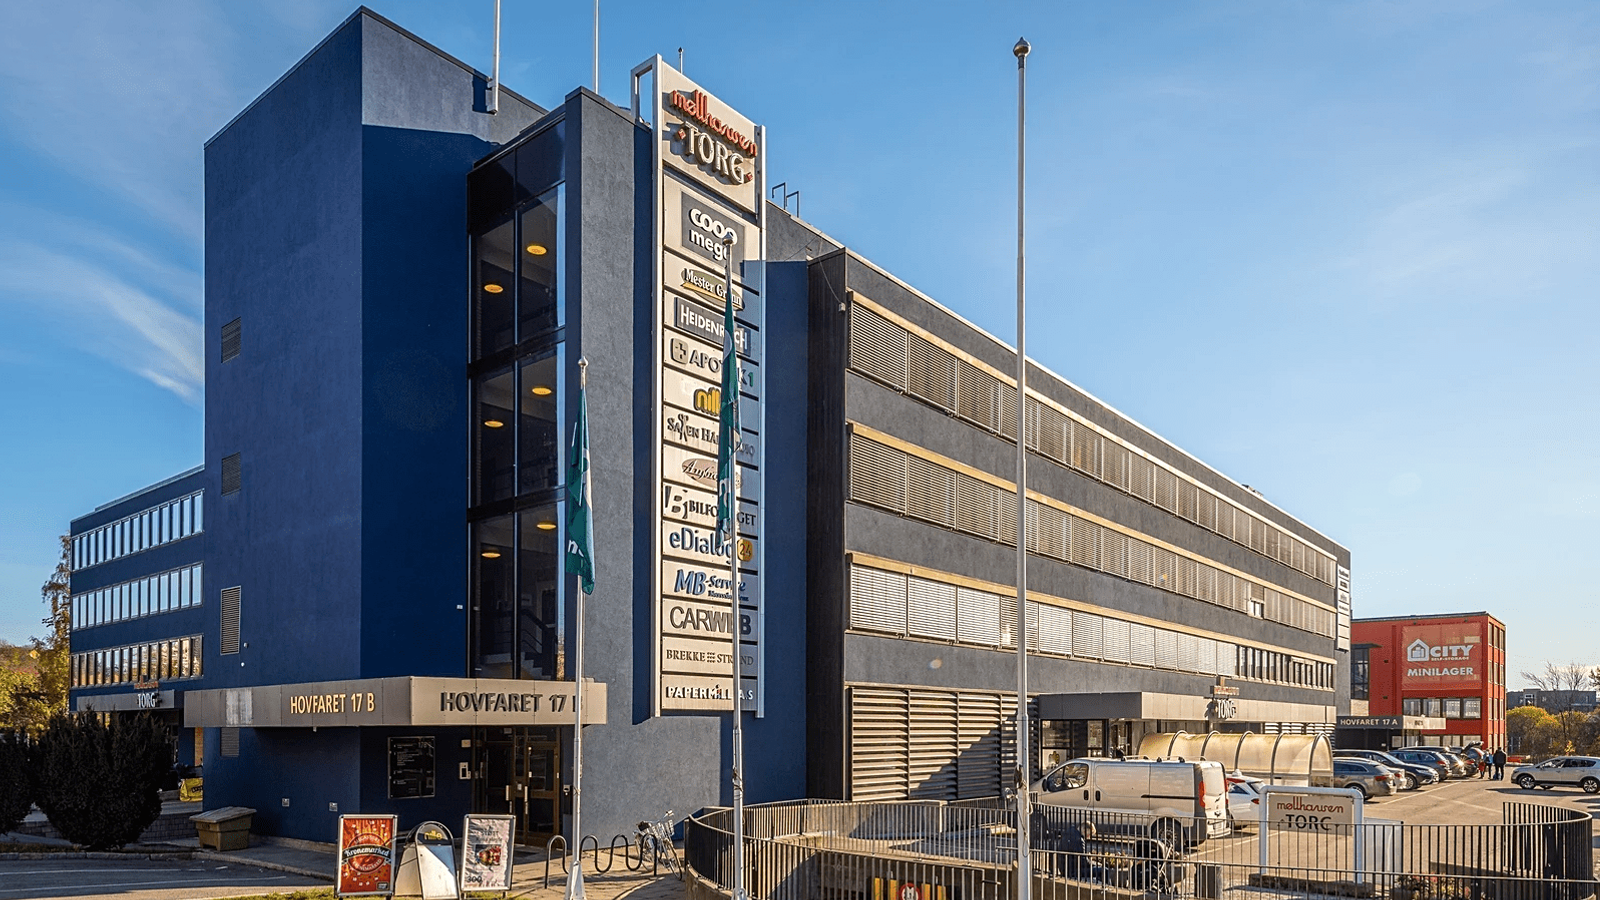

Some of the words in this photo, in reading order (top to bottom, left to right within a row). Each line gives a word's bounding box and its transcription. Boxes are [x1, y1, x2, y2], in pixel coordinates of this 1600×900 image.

[684, 121, 744, 184] TORG
[690, 229, 727, 261] meg
[685, 268, 714, 292] Mester
[715, 283, 741, 305] Grnn
[680, 304, 748, 351] HEIDENRCH
[696, 387, 720, 417] nill
[689, 499, 757, 527] BILFOGET
[674, 568, 746, 598] MB-Servce
[666, 649, 706, 662] BREKKE
[716, 653, 754, 666] STRND
[1430, 645, 1474, 658] CITY
[1406, 666, 1474, 677] MINILAGER
[137, 692, 156, 709] TORG
[290, 694, 347, 714] HOVFARET
[350, 692, 363, 713] 17
[367, 692, 375, 712] B
[440, 692, 544, 713] HOVFARET
[548, 694, 568, 713] 17
[1217, 699, 1236, 719] TORG
[1340, 718, 1380, 726] HOVFARET
[1382, 718, 1390, 726] 17
[1391, 718, 1399, 726] A
